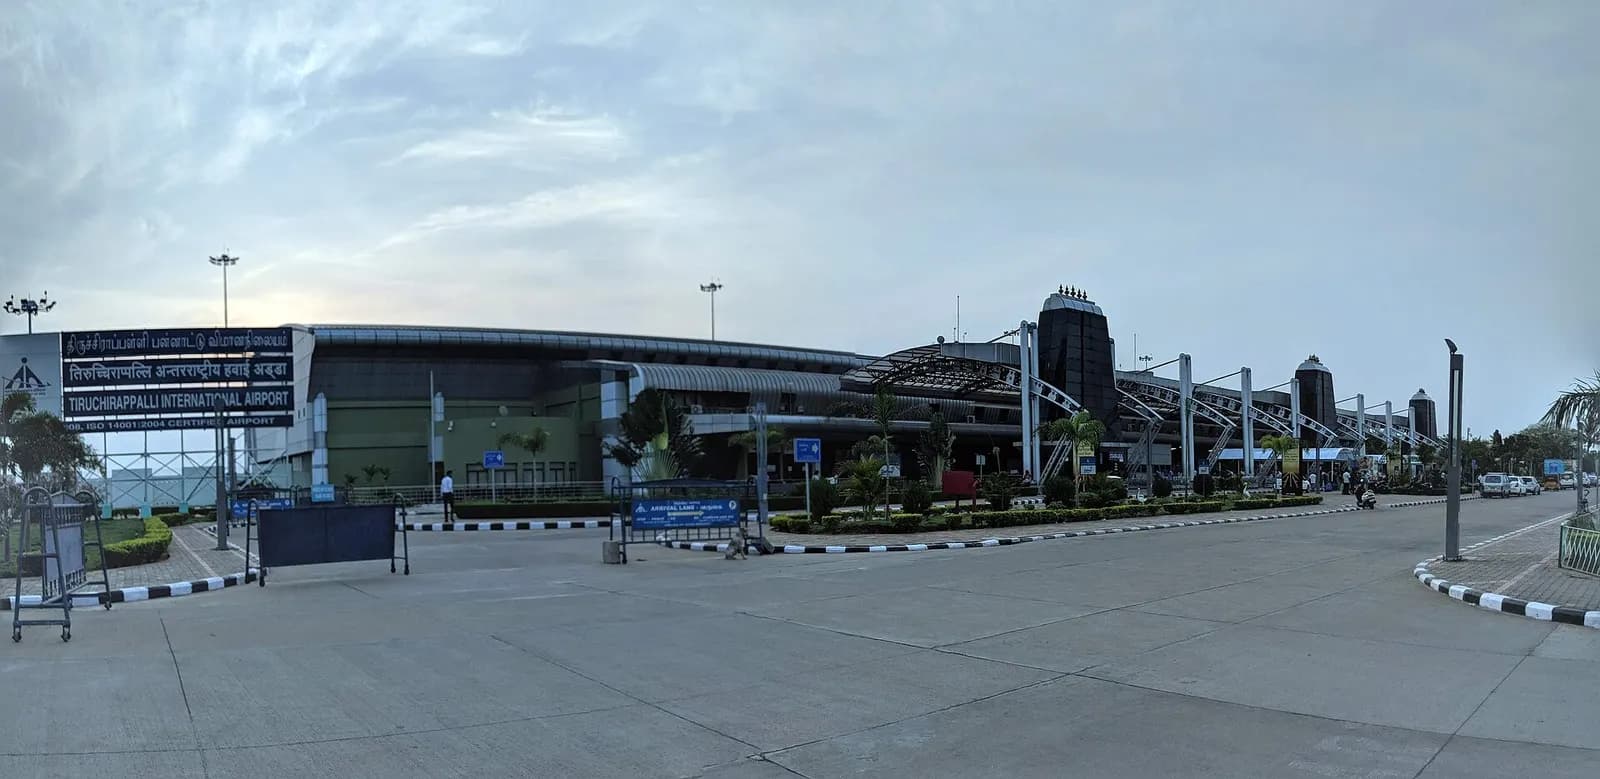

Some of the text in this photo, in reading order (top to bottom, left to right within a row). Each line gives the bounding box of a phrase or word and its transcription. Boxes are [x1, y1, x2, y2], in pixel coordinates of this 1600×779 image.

[152, 332, 206, 351] பன்னாட்டு
[224, 359, 250, 377] हवाई
[68, 395, 159, 412] TIRUCHIRAPPALLI
[244, 391, 288, 406] AIRPORT
[86, 422, 105, 430] ISO
[227, 417, 275, 425] AIRPORT
